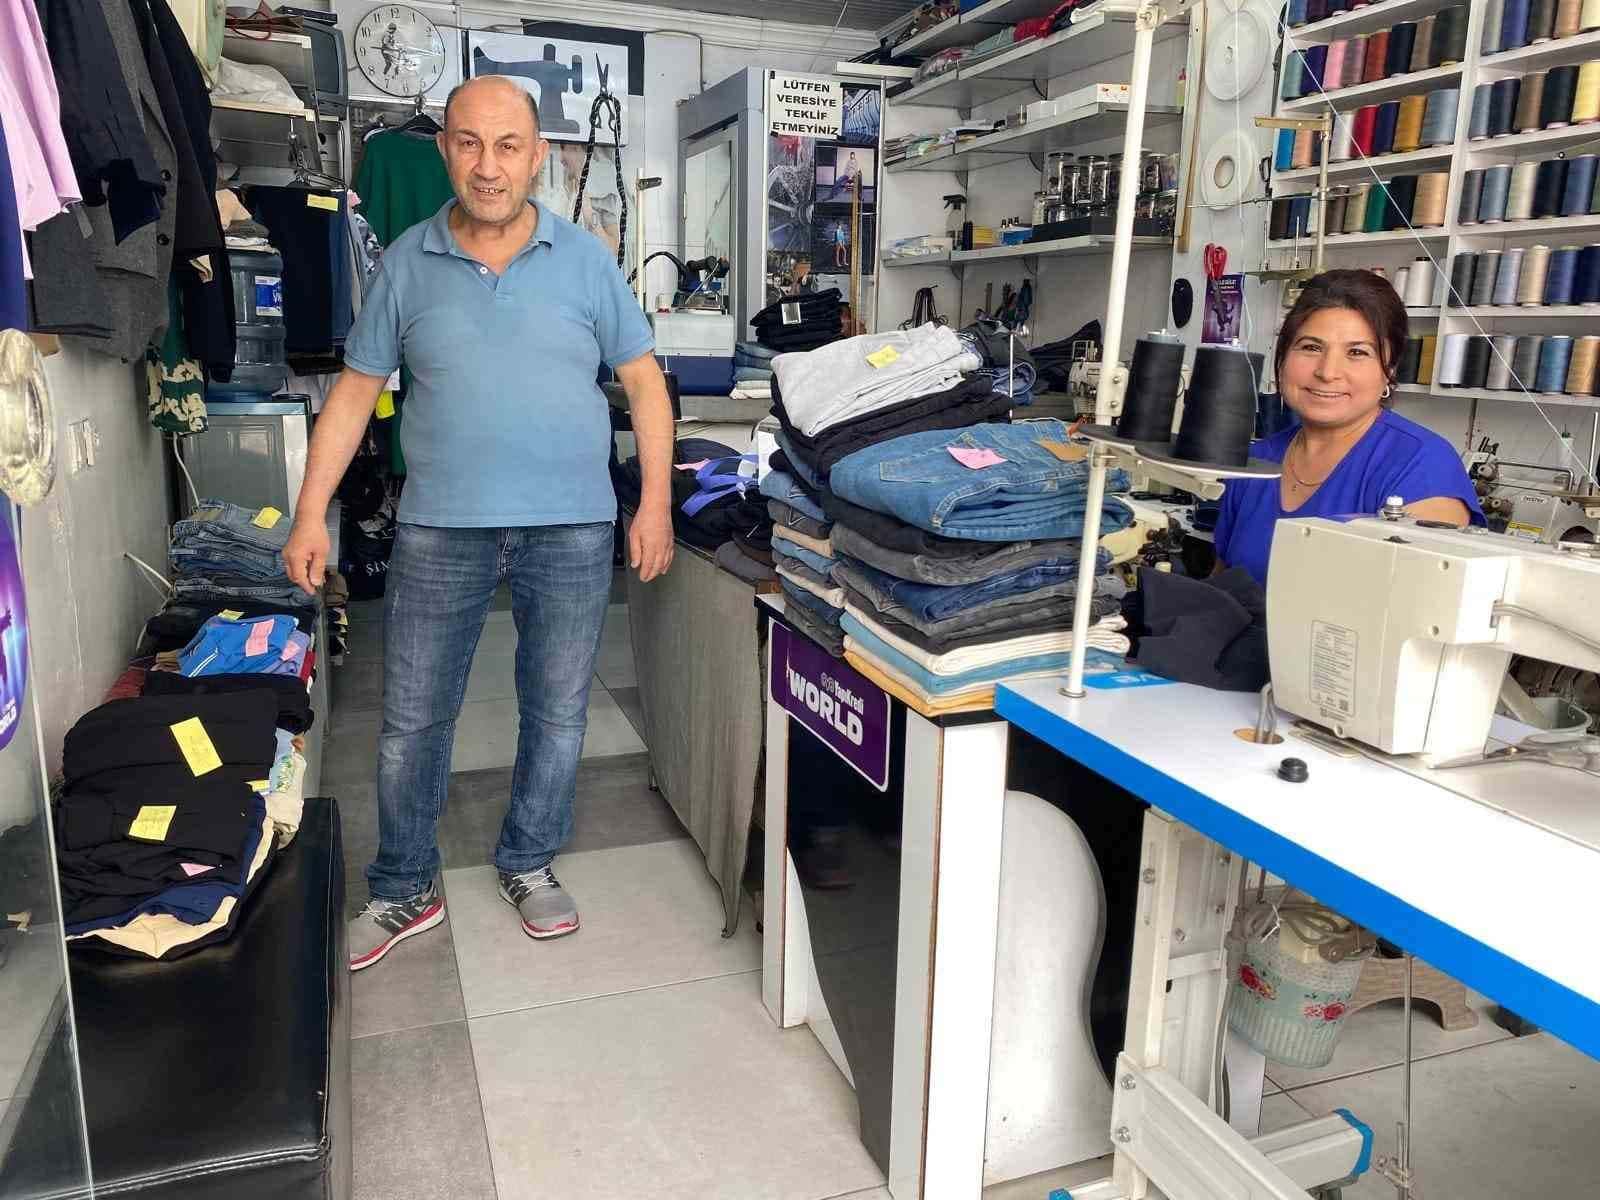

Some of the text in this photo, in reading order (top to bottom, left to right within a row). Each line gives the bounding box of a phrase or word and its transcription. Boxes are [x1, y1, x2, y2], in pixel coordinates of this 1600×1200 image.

[373, 12, 381, 24] 11
[390, 7, 400, 19] 12
[384, 78, 390, 89] 7
[783, 80, 830, 93] LÜTFEN
[777, 94, 837, 107] VERESİYE
[785, 109, 828, 120] TEKLİF
[772, 122, 839, 136] ETMEYİNİZ
[789, 668, 864, 746] WORLD
